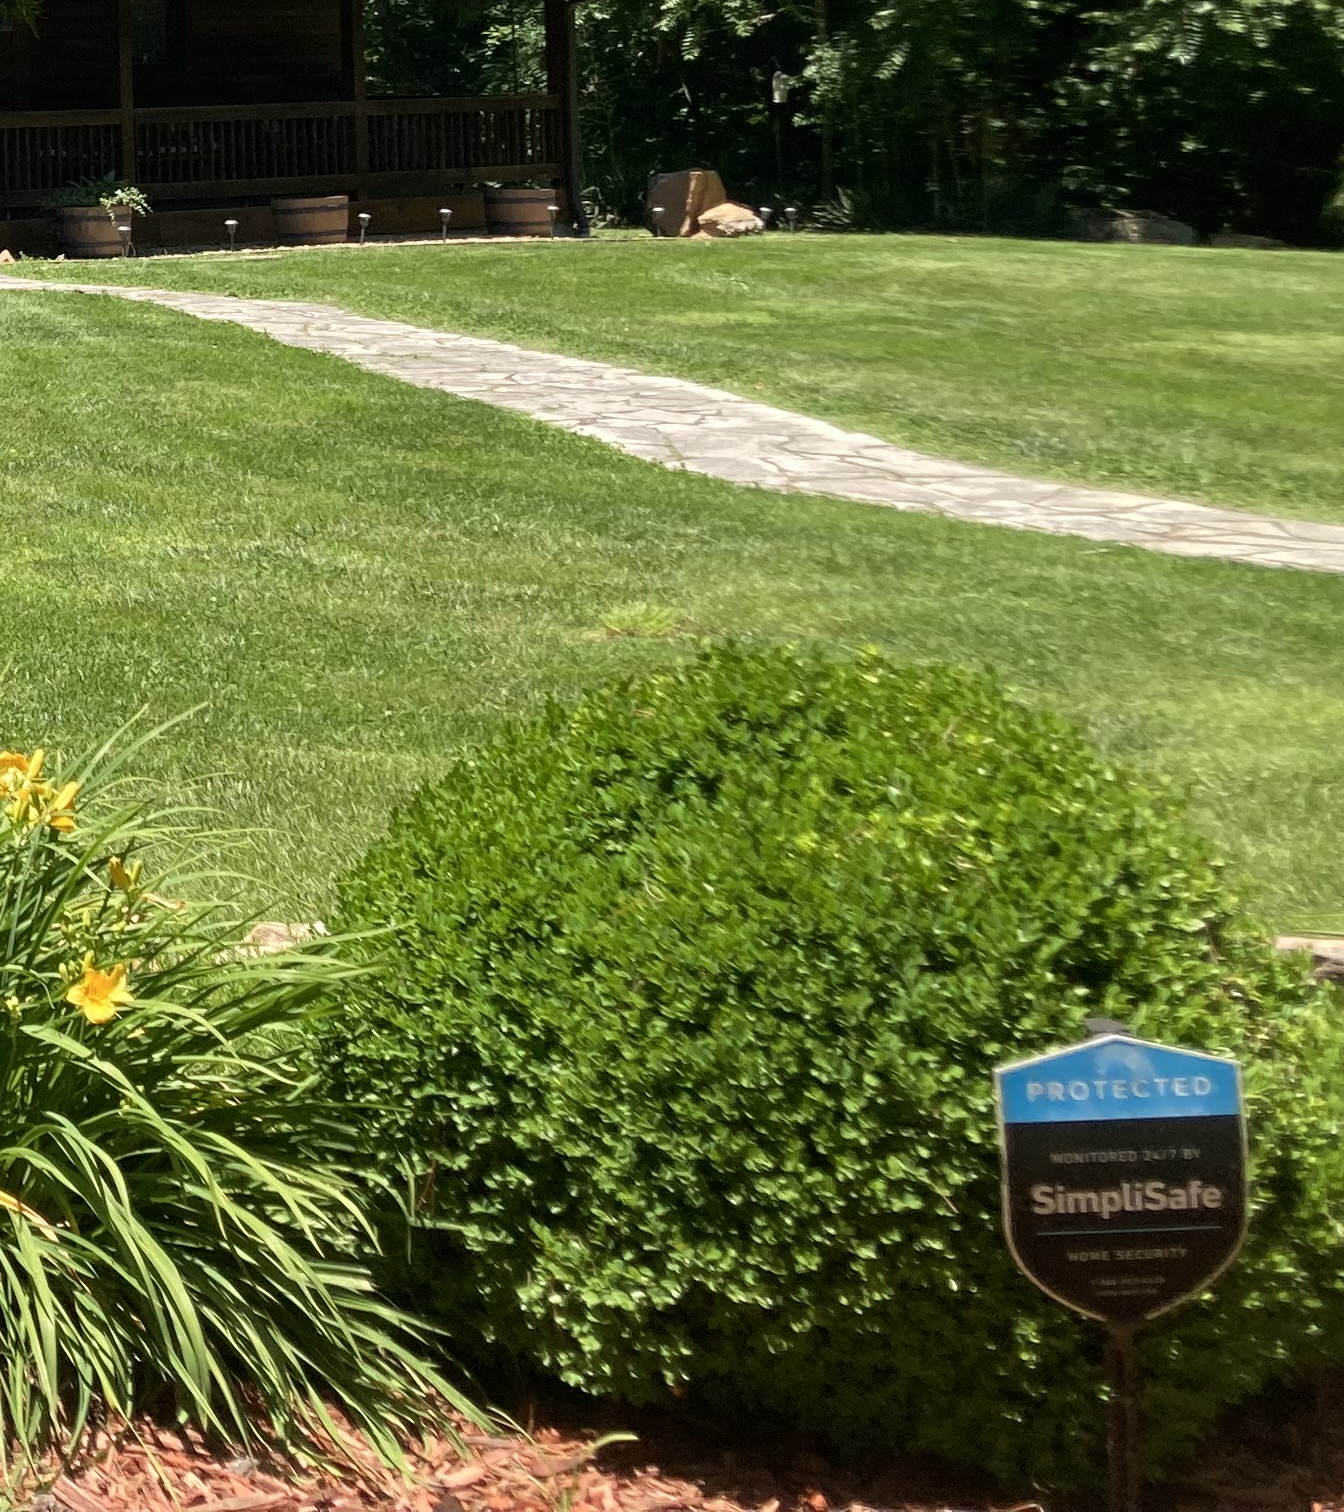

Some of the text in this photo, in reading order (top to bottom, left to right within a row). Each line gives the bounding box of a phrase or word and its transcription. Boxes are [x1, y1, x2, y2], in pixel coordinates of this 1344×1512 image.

[1026, 1076, 1213, 1103] PROTECTED
[1049, 1147, 1200, 1164] MONITORED 24/7 BY
[1030, 1179, 1223, 1219] SimpliSafe
[1067, 1247, 1188, 1262] HOME SECURITY
